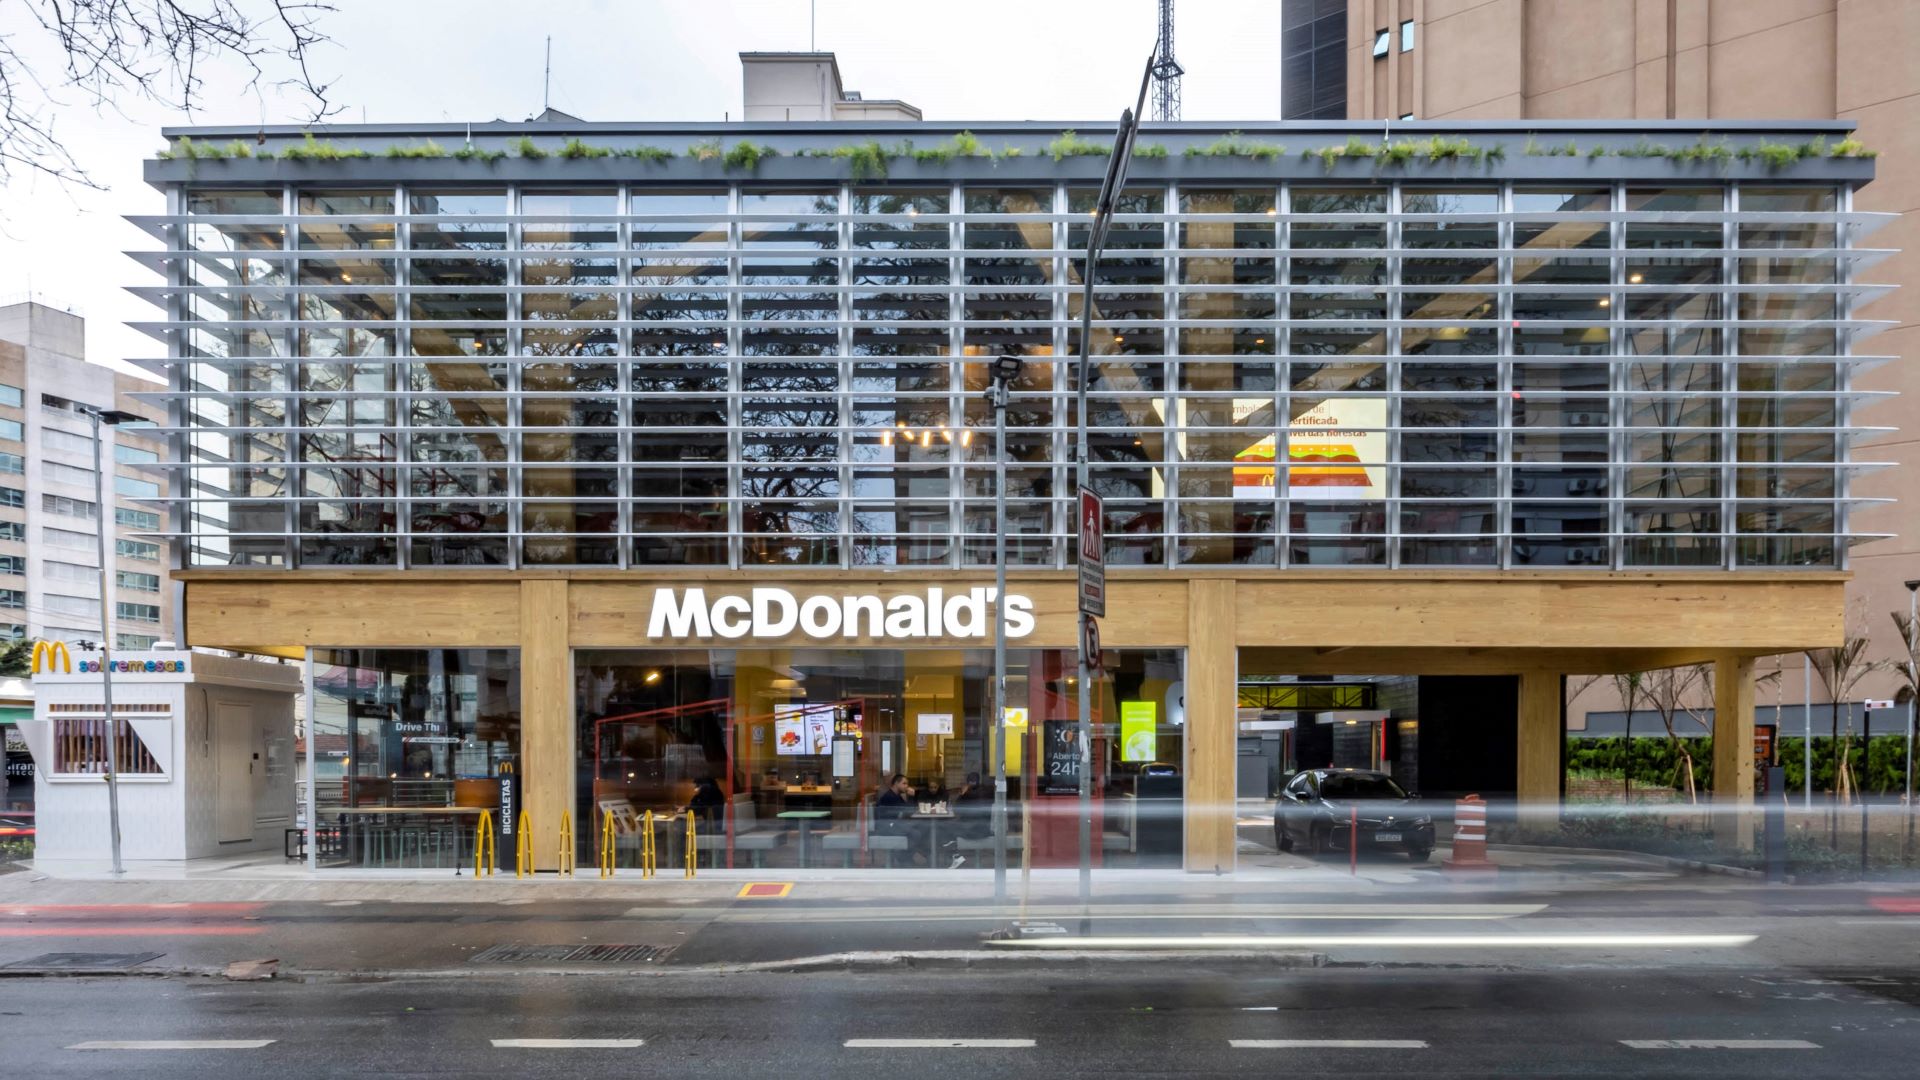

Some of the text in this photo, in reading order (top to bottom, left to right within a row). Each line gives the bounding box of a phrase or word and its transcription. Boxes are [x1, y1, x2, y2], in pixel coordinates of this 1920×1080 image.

[1290, 416, 1338, 425] ertificada
[646, 587, 1036, 639] McDonald's
[395, 722, 423, 732] Drive
[1052, 752, 1080, 760] Aberto
[1051, 761, 1081, 776] 24h
[502, 779, 511, 835] BICICLETAS
